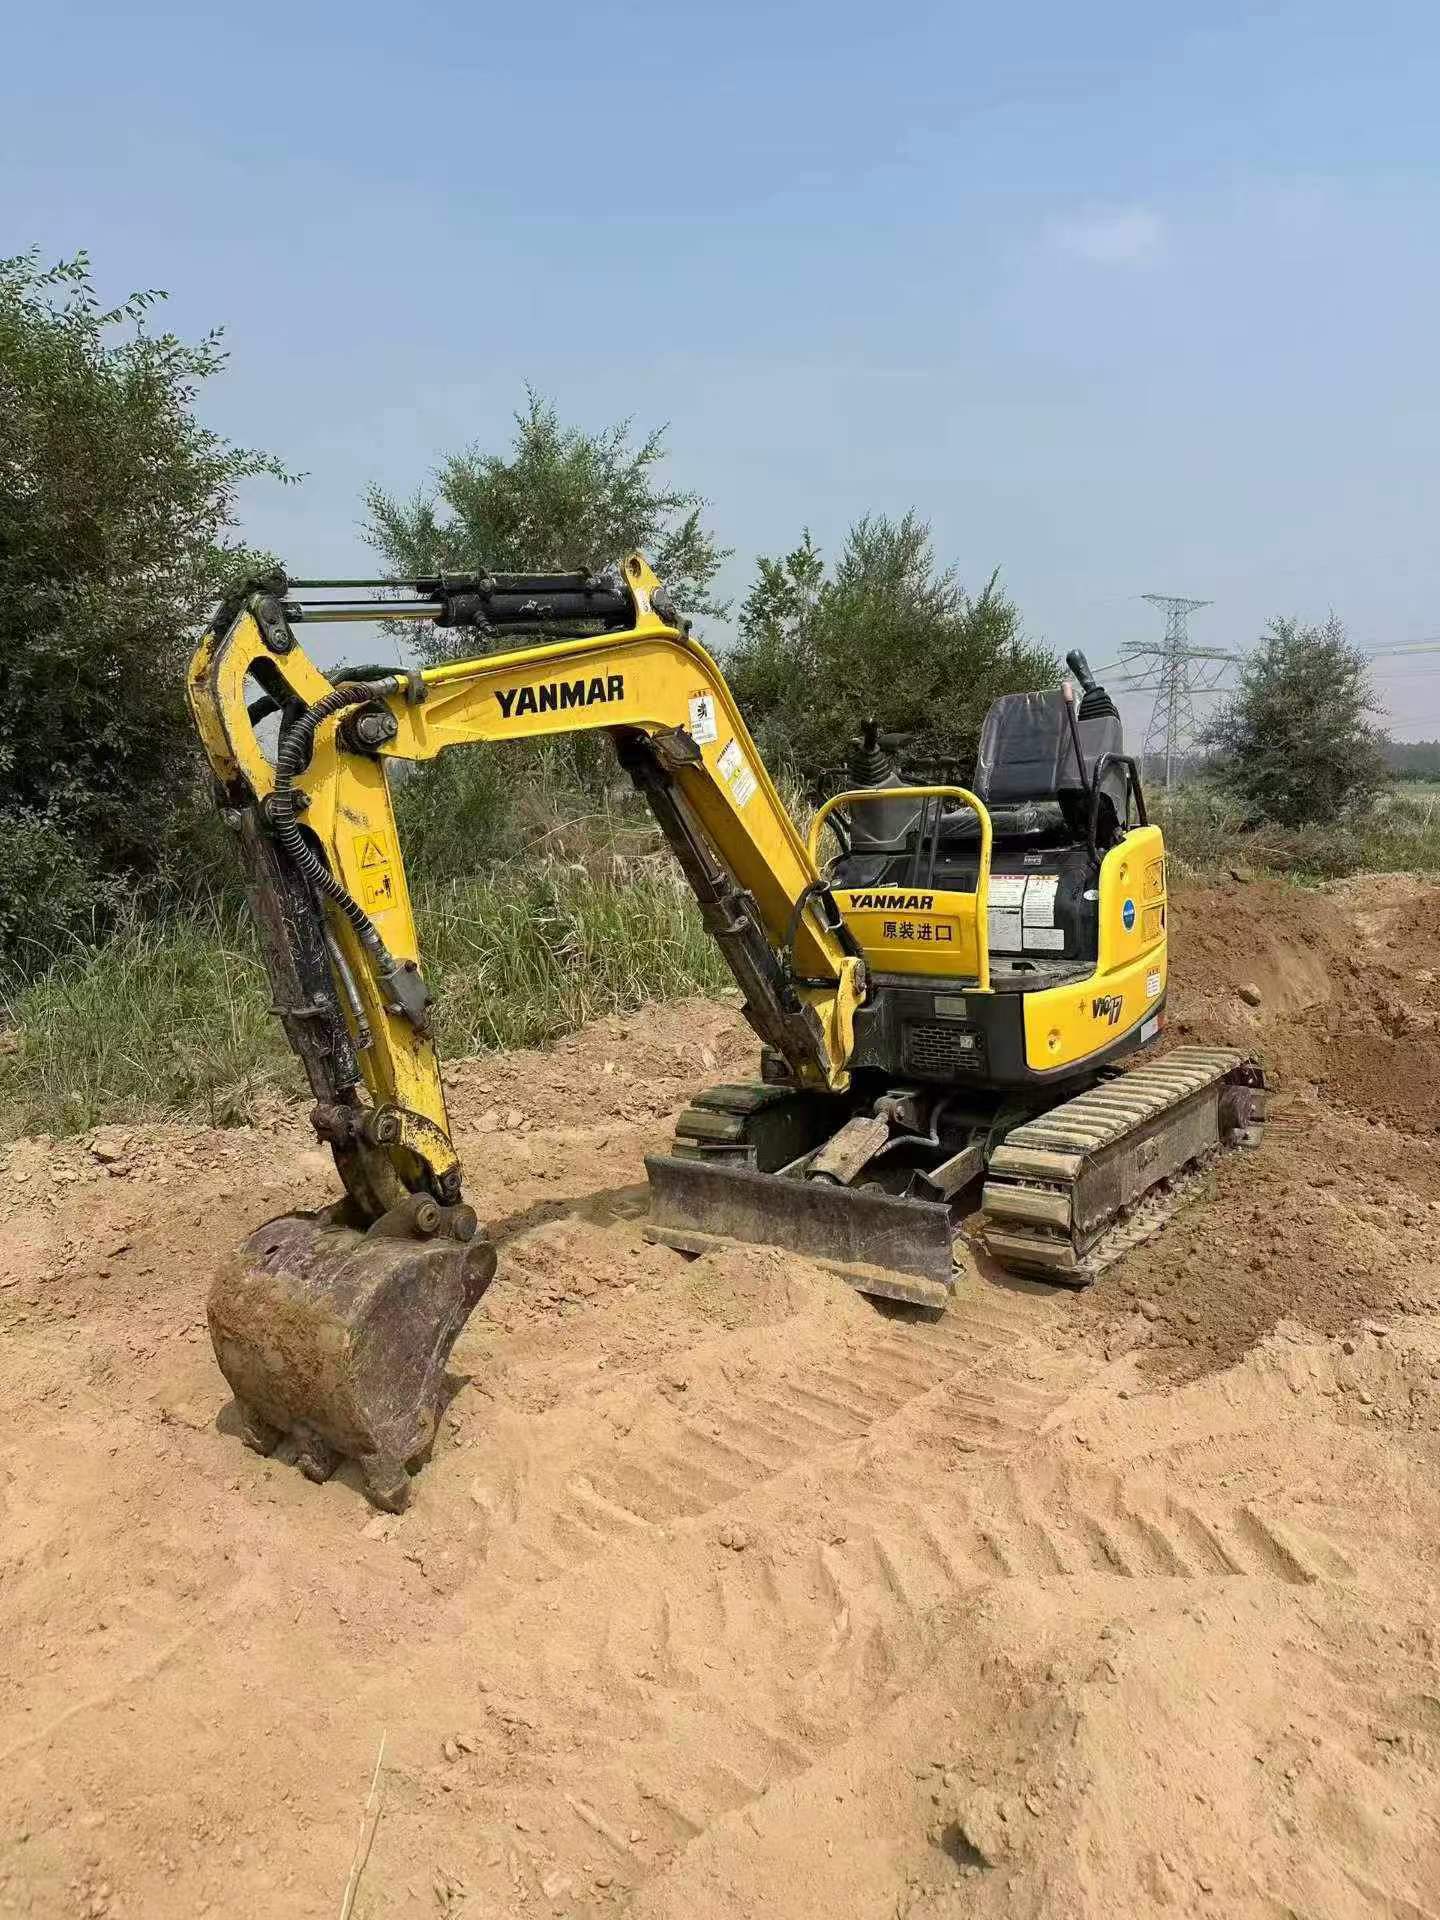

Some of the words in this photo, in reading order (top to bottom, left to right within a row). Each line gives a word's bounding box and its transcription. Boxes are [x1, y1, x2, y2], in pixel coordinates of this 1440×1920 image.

[494, 675, 624, 718] YANMAR
[849, 894, 934, 910] YANMAR
[883, 921, 953, 941] 原装进口
